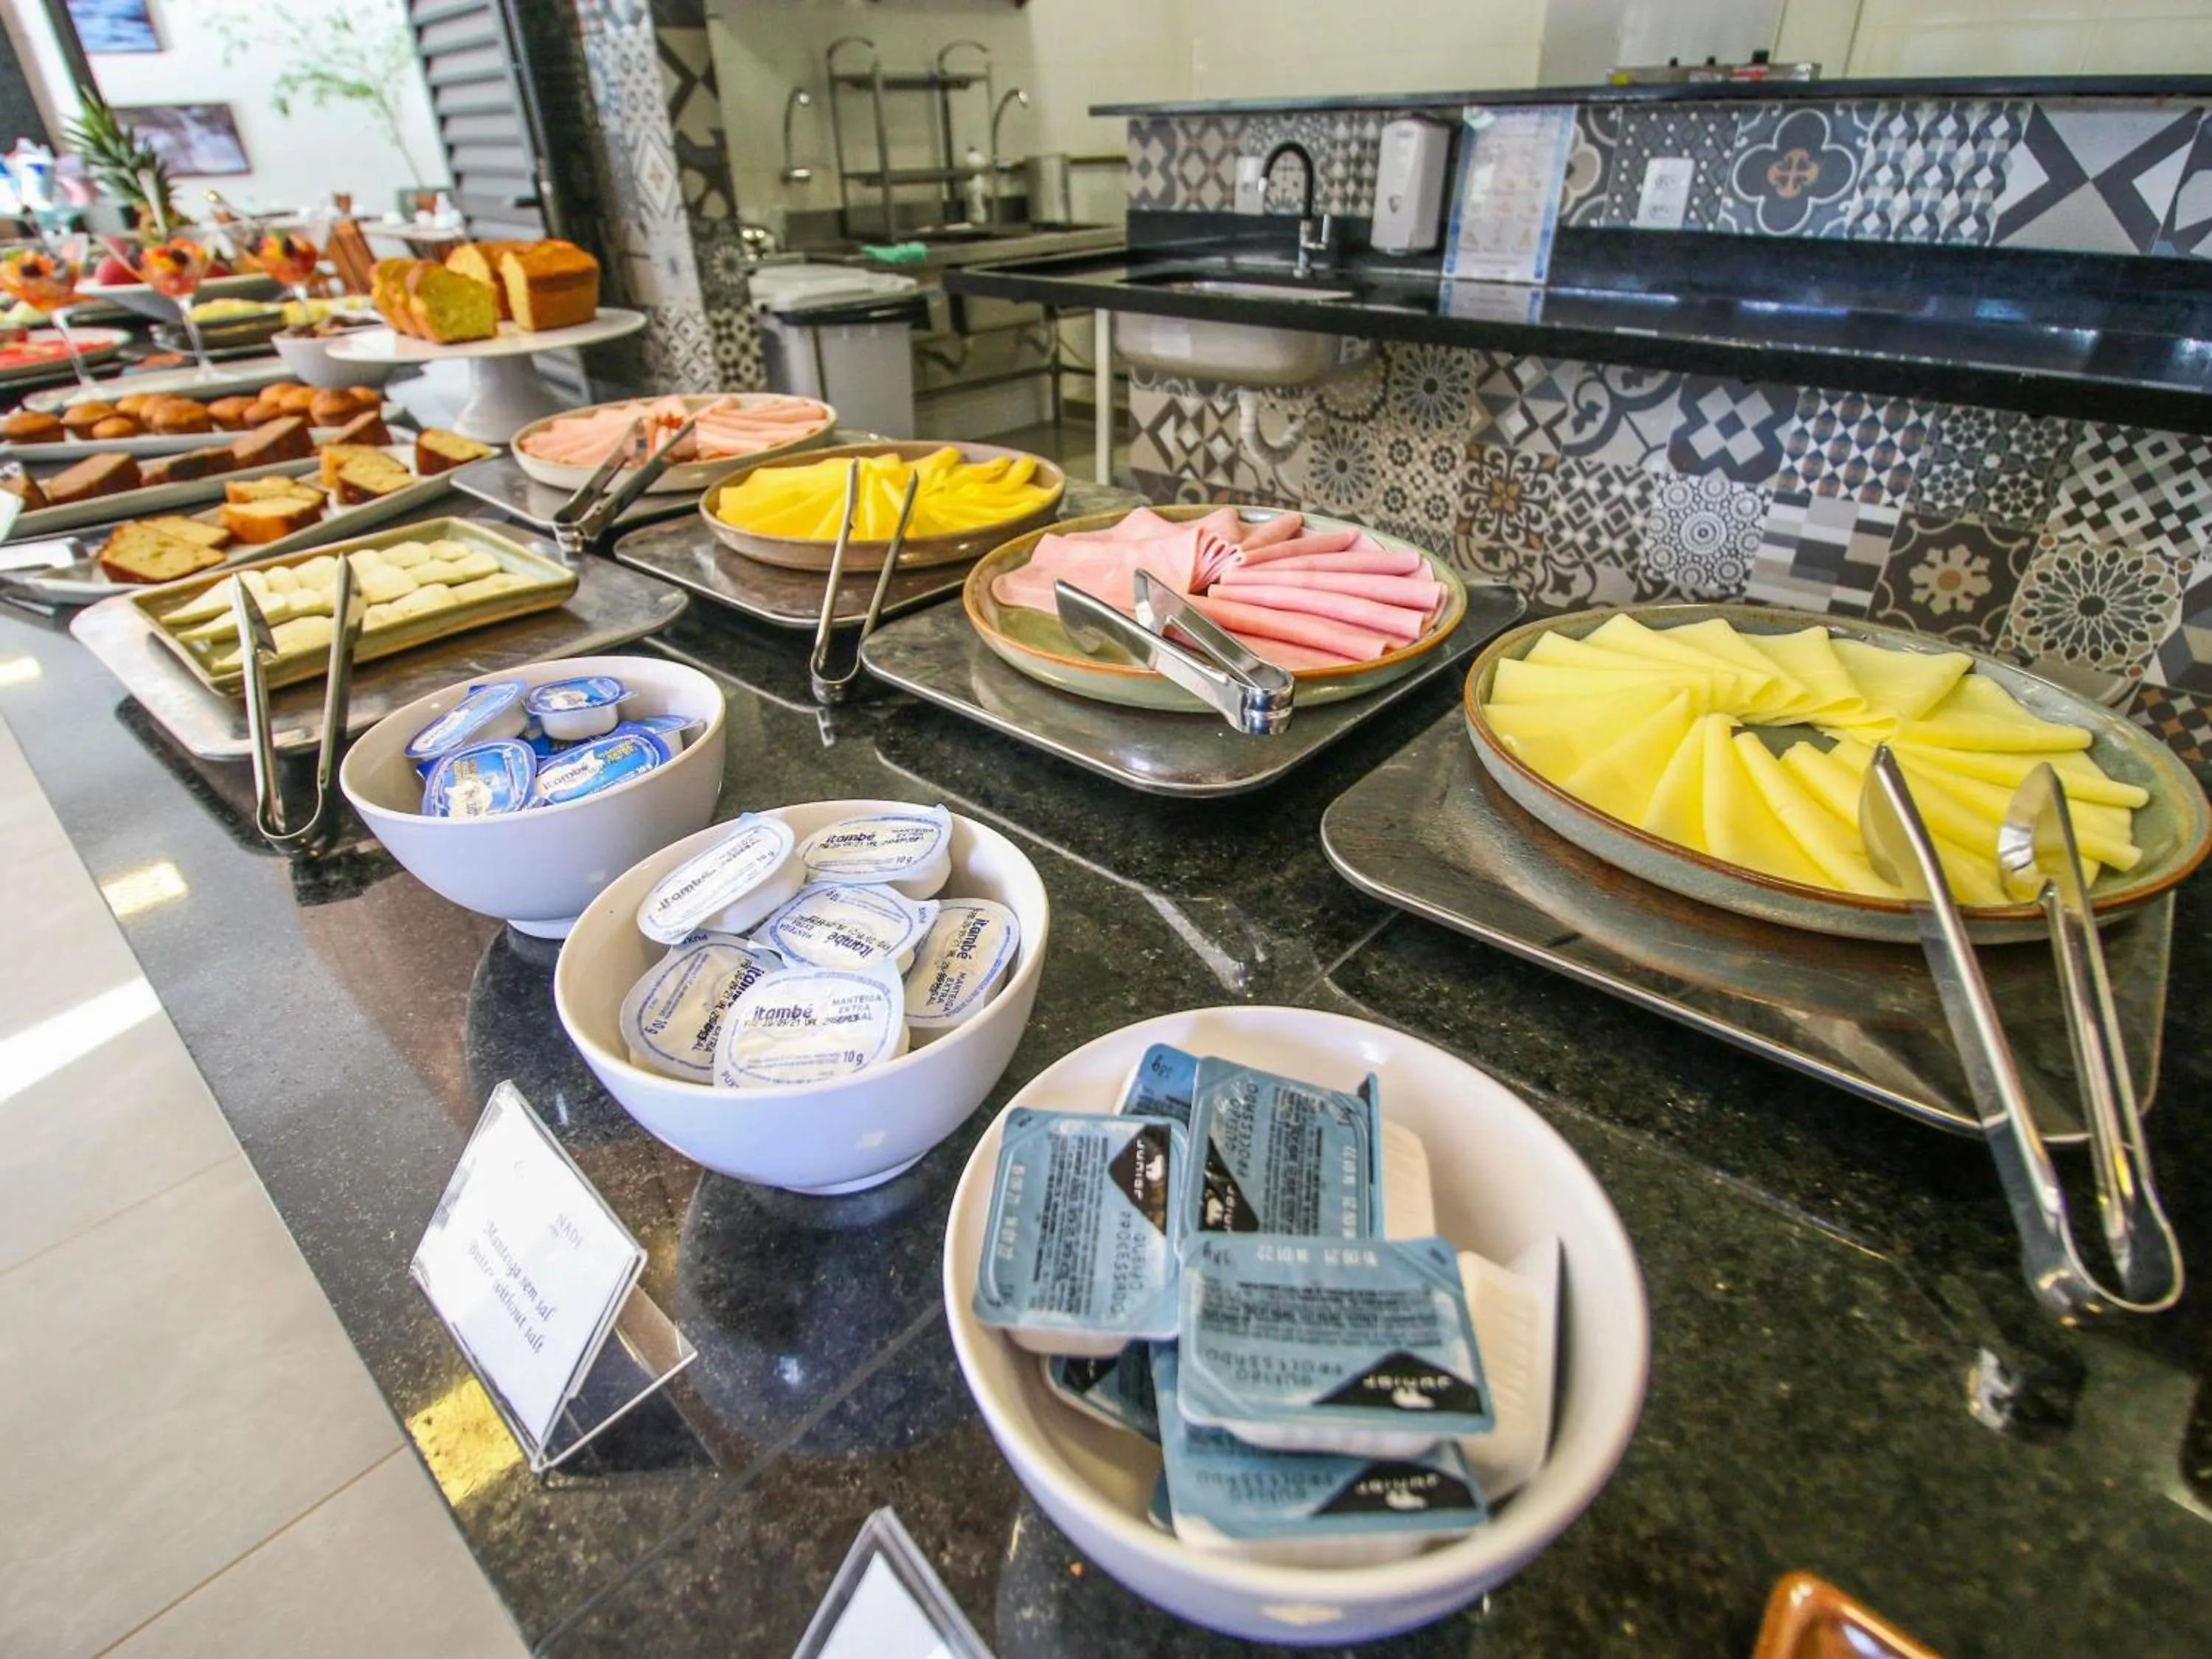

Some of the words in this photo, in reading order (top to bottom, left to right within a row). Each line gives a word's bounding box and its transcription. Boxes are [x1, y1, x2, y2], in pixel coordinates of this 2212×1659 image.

[827, 832, 876, 844] itambé
[824, 931, 874, 958] itambé
[956, 918, 990, 959] itambé
[832, 995, 883, 1006] MANTEIGA
[936, 977, 956, 1004] EXTRA
[942, 971, 967, 1012] MANTEIGA
[753, 1004, 814, 1020] itambé
[838, 1004, 870, 1014] EXTRA
[843, 1051, 855, 1063] 10
[855, 1053, 863, 1065] g
[1225, 1097, 1243, 1152] QUEIJO
[1237, 1083, 1260, 1179] PROCESSADO
[483, 1219, 522, 1279] Manteiga
[521, 1276, 538, 1303] sem
[535, 1300, 558, 1322] sal
[1110, 1210, 1132, 1315] PROCESSADO
[467, 1239, 495, 1277] Butter
[493, 1279, 527, 1329] without
[524, 1326, 546, 1354] salt
